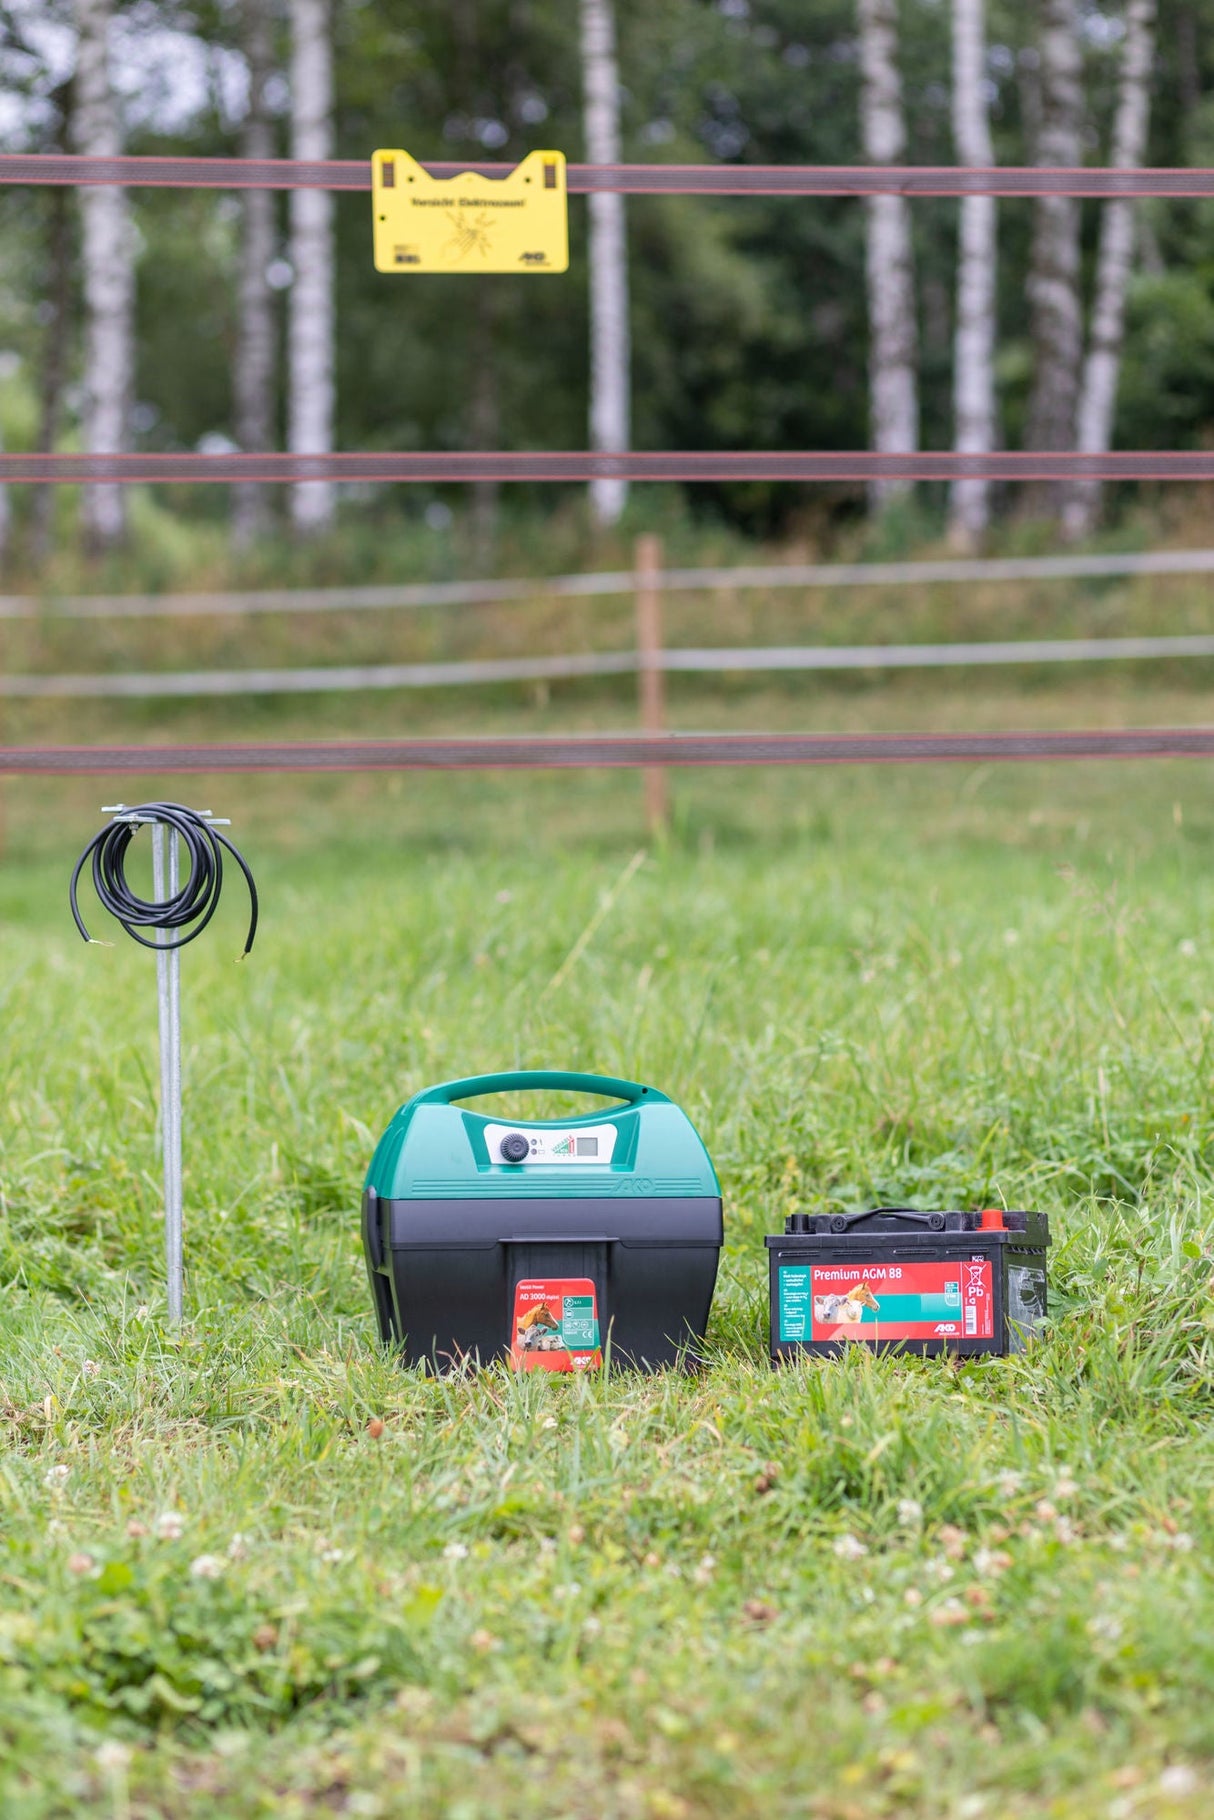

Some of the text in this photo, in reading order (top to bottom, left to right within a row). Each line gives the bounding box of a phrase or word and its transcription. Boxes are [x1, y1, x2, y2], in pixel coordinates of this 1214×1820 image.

[814, 1268, 860, 1280] Premium
[862, 1268, 887, 1279] AGM
[888, 1267, 902, 1279] 88
[530, 1292, 546, 1300] 3000
[968, 1286, 984, 1297] Pb
[934, 1323, 956, 1333] AKO
